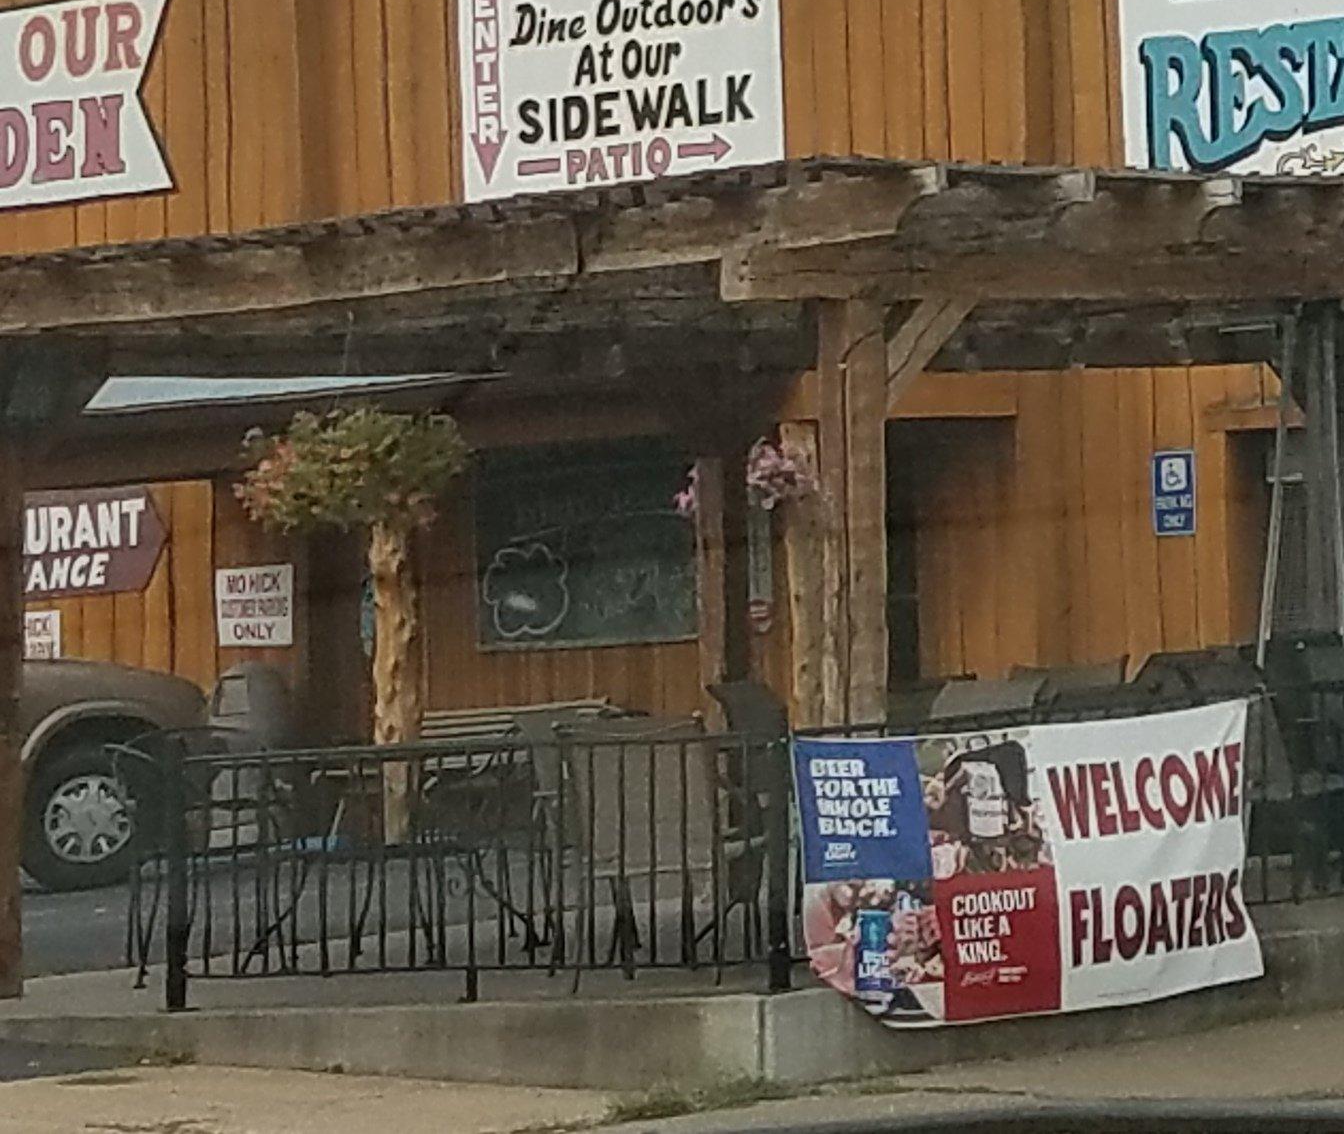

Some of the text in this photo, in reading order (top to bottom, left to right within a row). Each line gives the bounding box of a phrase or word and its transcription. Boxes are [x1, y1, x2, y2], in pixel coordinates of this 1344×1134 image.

[19, 2, 142, 81] OUR
[510, 2, 586, 47] Dine
[574, 39, 681, 87] At Our
[518, 73, 754, 145] SIDEWALK
[566, 137, 672, 185] PATIO
[23, 496, 145, 555] URANT
[24, 552, 110, 592] ANCE
[234, 623, 275, 640] ONLY
[810, 759, 865, 777] BEER
[813, 777, 901, 798] FOR THE
[816, 797, 891, 818] WHOLE
[1048, 742, 1241, 839] WELCOME
[952, 887, 1036, 916] COOKOUT
[1068, 869, 1246, 967] FLOATERS
[954, 915, 1011, 940] LIKE A
[957, 939, 1008, 965] KING.
